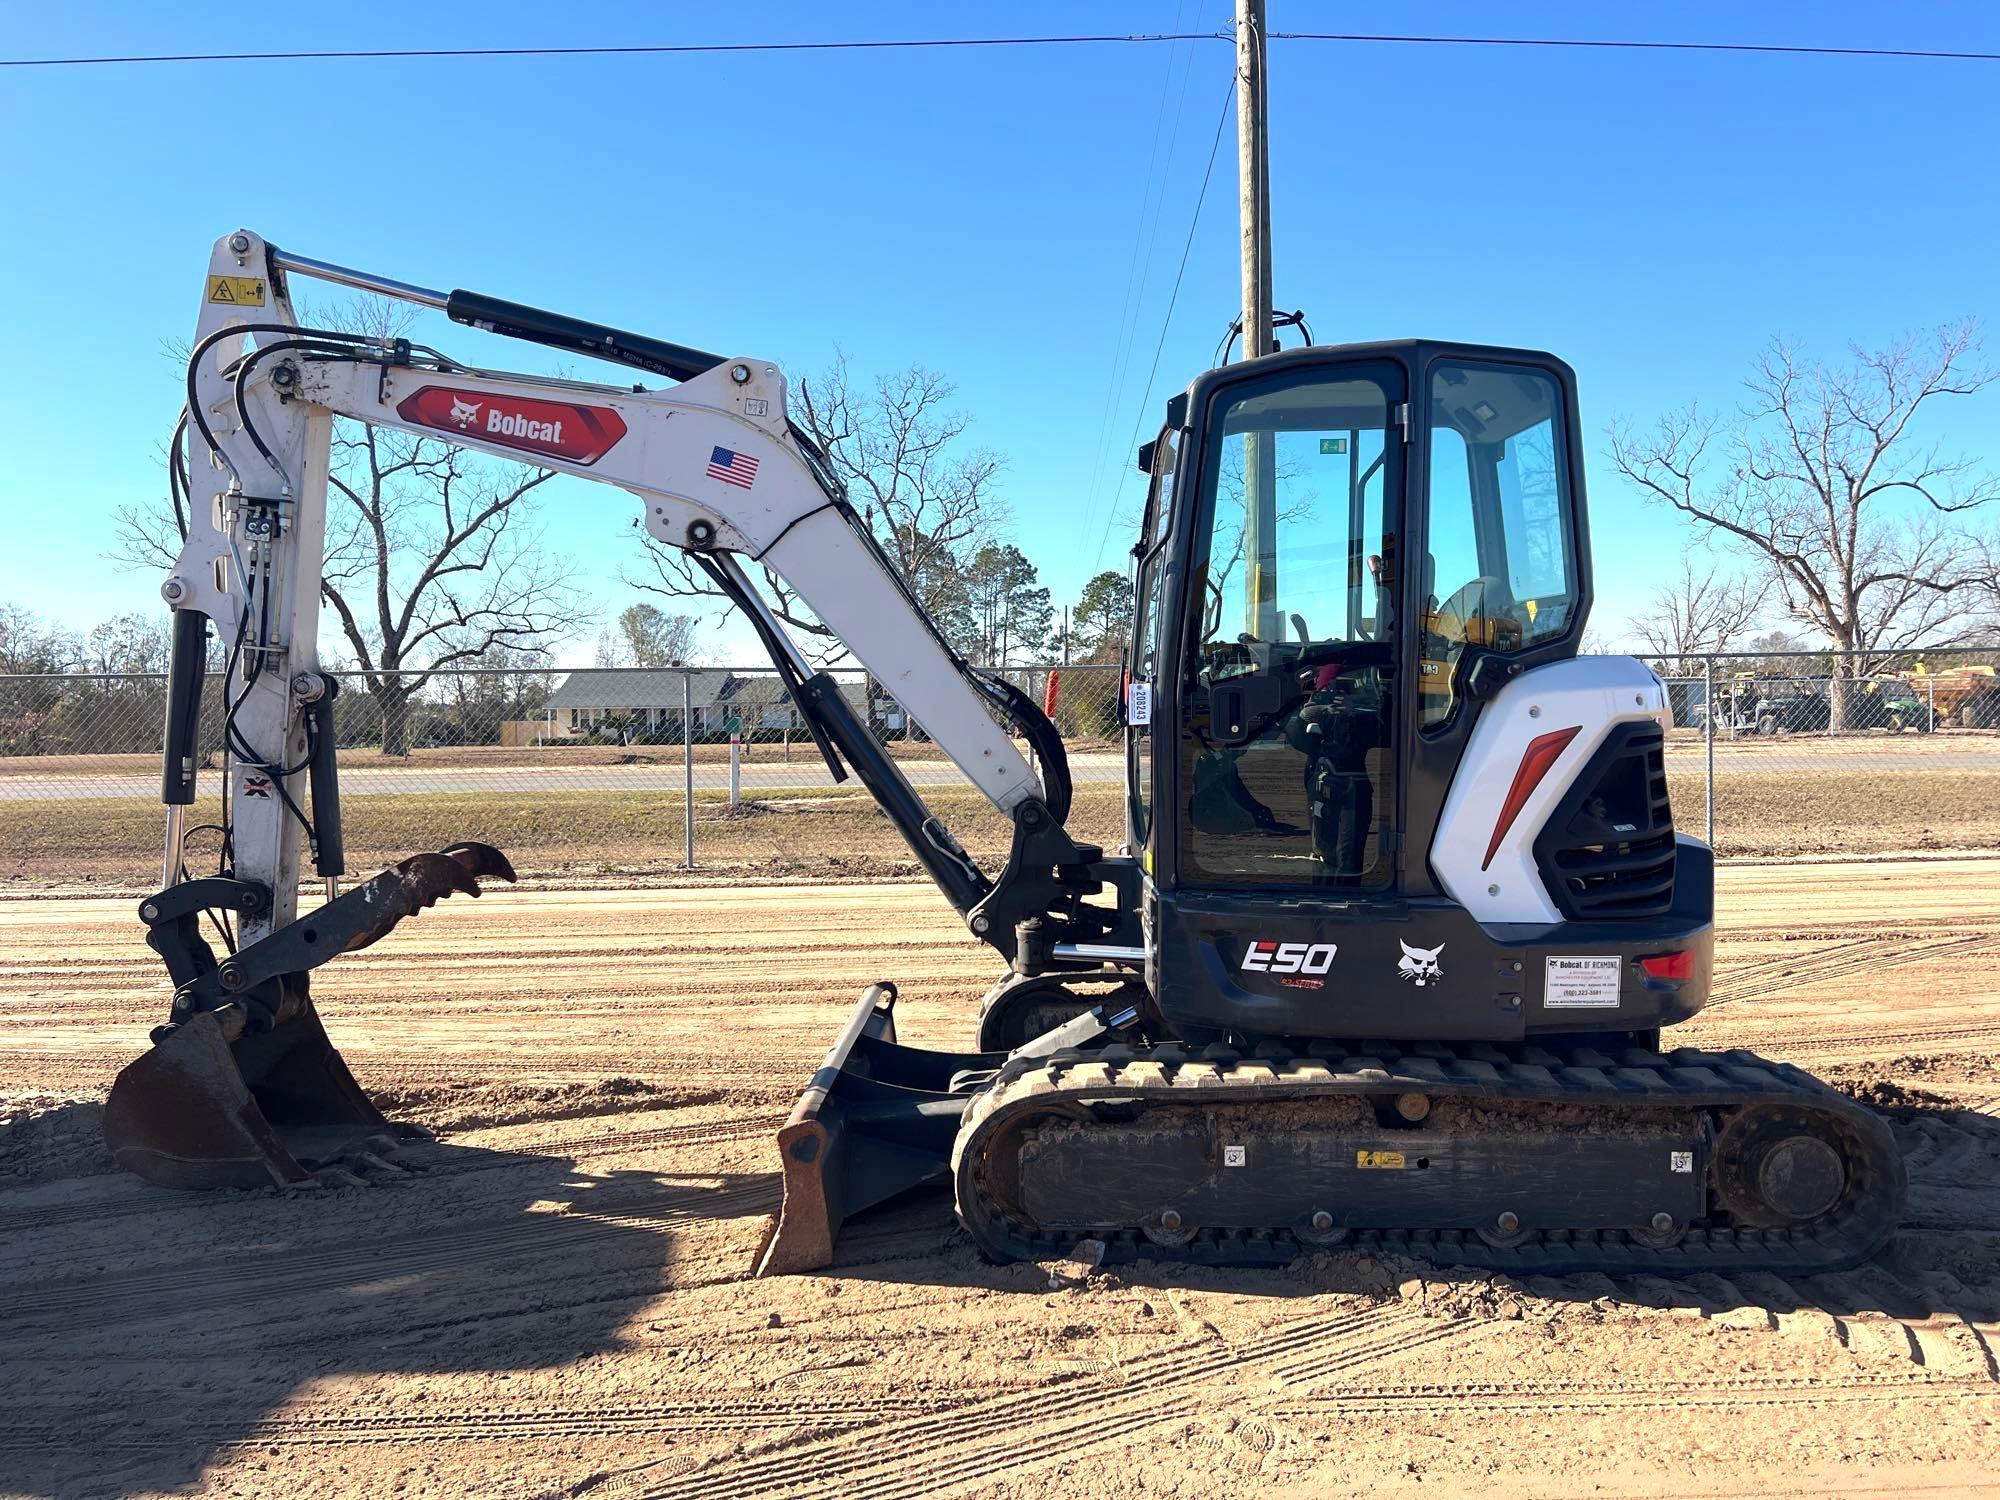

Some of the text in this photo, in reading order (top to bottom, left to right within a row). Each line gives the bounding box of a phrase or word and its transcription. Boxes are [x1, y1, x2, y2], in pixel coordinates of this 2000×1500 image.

[487, 409, 563, 444] Bobcat
[1136, 691, 1147, 720] 208243
[1241, 941, 1338, 974] E50
